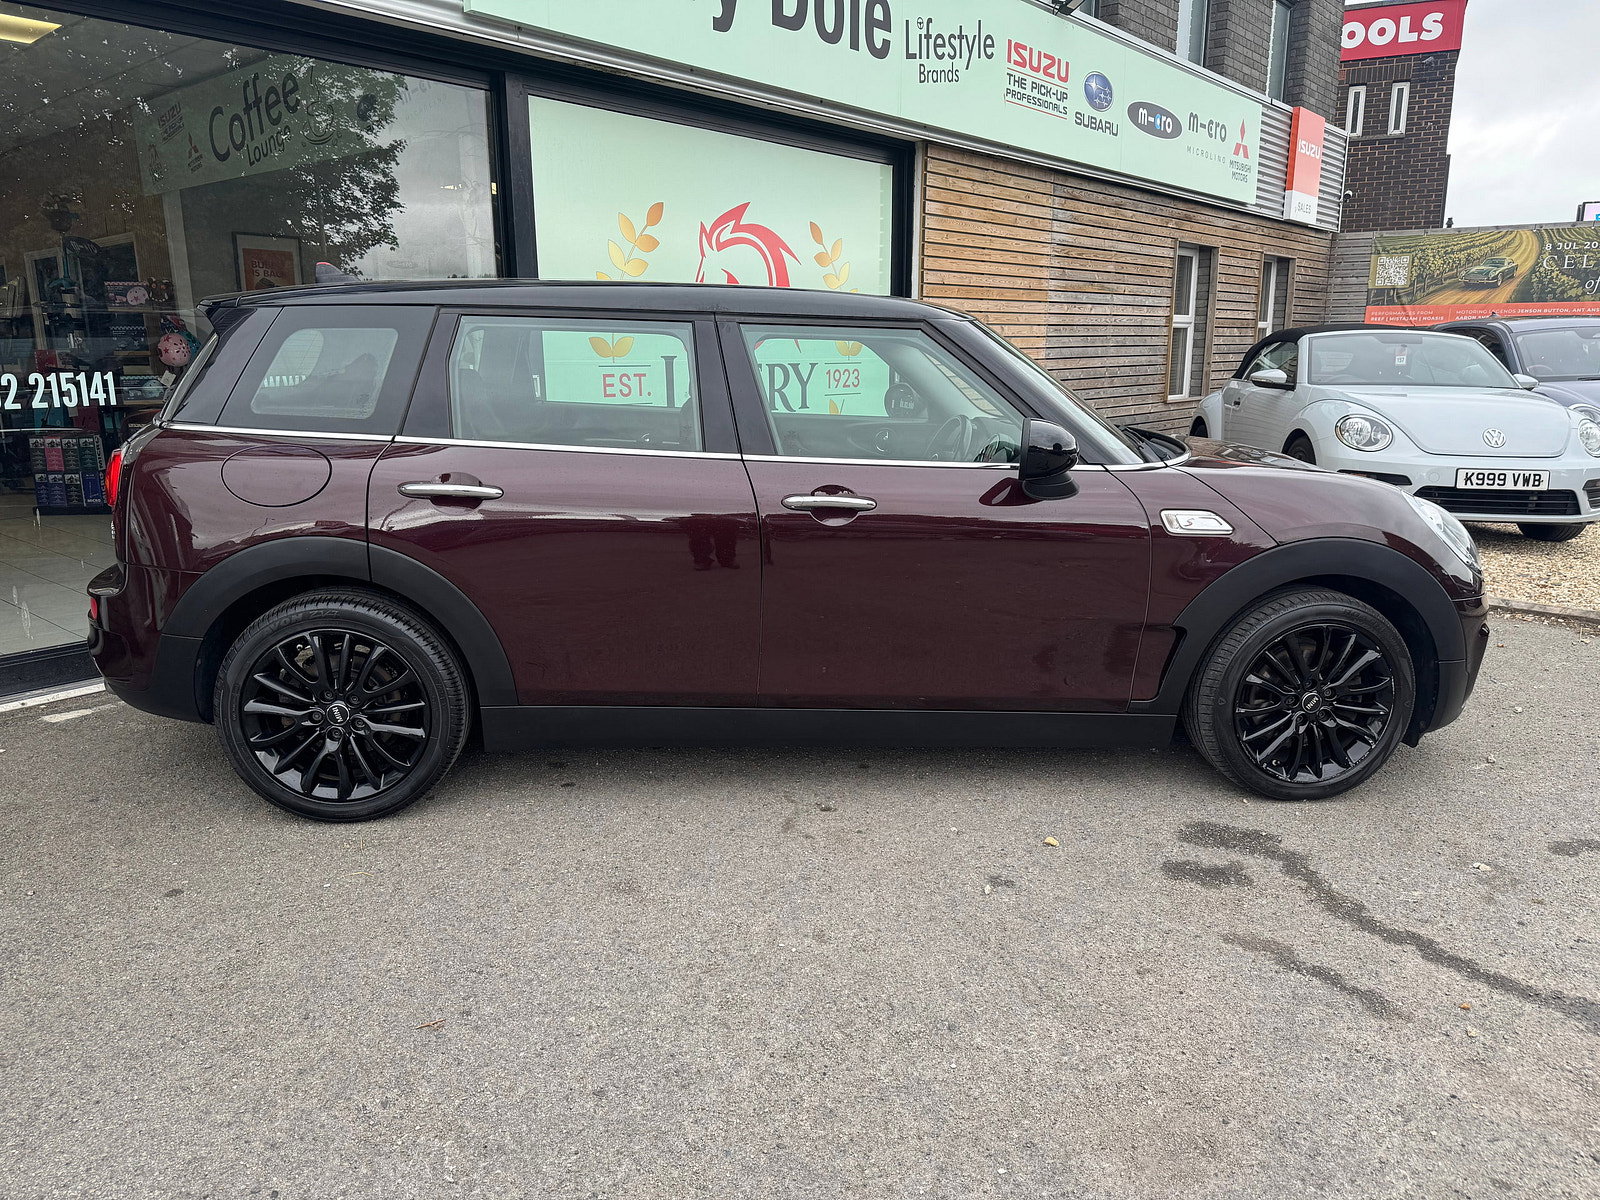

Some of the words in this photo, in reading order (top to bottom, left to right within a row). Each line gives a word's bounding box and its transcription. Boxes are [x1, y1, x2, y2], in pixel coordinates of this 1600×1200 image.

[905, 17, 996, 70] Lifestyle
[1006, 38, 1070, 83] ISUZU
[918, 63, 960, 84] Brands
[1006, 72, 1027, 90] THE
[1030, 80, 1068, 103] PICK-UP
[1005, 87, 1068, 115] PROFESSIONALS
[209, 72, 301, 162] Coffee
[1074, 111, 1119, 137] SUBARU
[246, 124, 291, 167] Lounge
[1186, 145, 1226, 164] MICROLINO
[1298, 139, 1321, 160] ISUZU
[1229, 159, 1252, 174] MITSUBISHI
[1231, 170, 1248, 183] MOTORS
[1297, 201, 1312, 215] SALES
[1545, 243, 1552, 251] 8
[1556, 242, 1579, 250] JUL
[1584, 241, 1600, 249] 20
[263, 269, 286, 278] BAC
[602, 373, 652, 398] EST.
[825, 368, 861, 390] 1923
[0, 372, 22, 411] 2
[28, 371, 117, 409] 215141
[1464, 472, 1507, 486] K999
[1512, 473, 1542, 487] VWB
